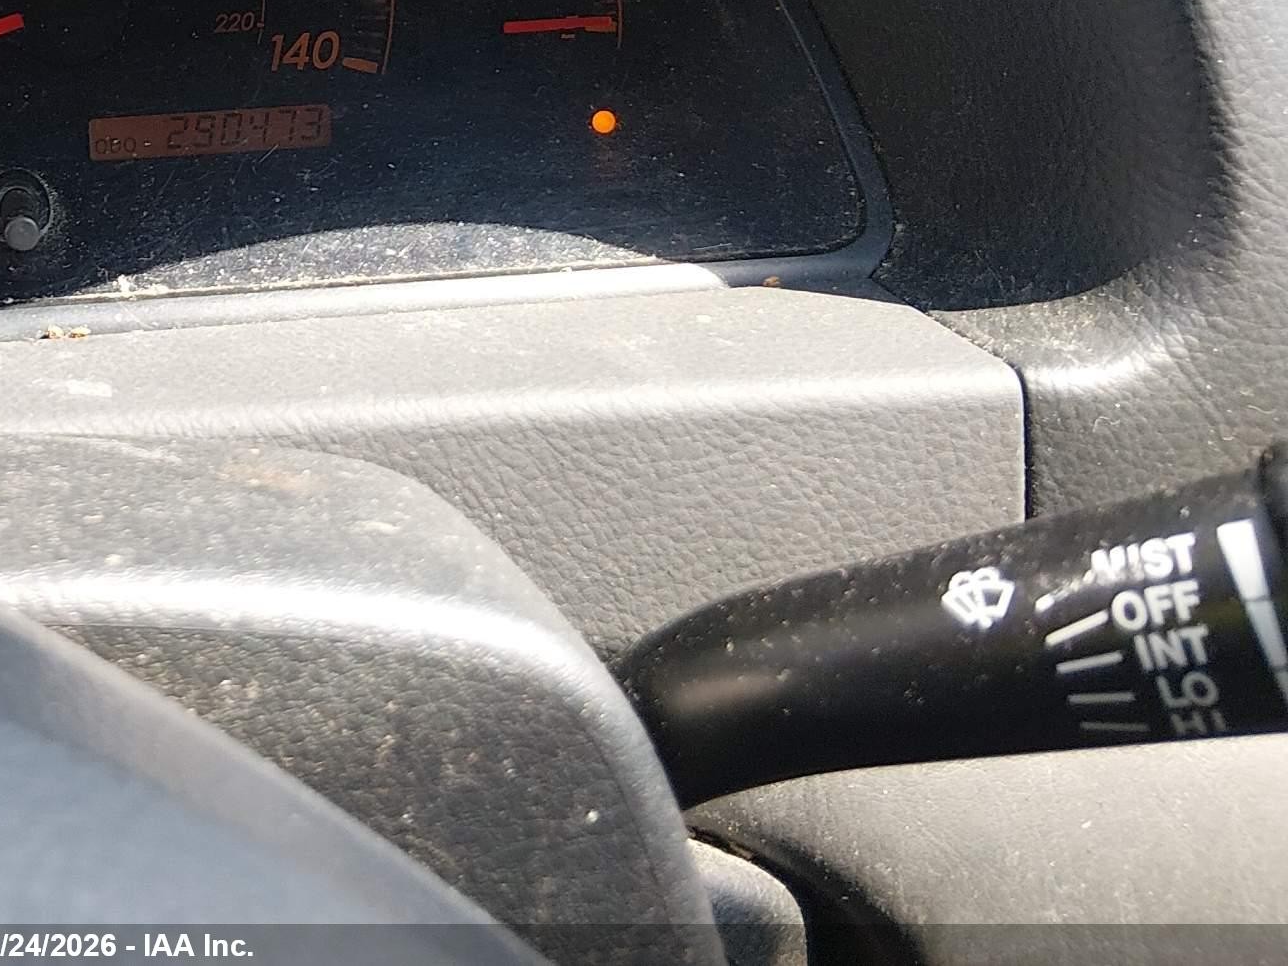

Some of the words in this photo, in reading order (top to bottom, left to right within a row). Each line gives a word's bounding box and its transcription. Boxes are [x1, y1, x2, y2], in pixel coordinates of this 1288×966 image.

[215, 11, 255, 33] 220
[272, 30, 342, 70] 140
[166, 107, 325, 150] 290473
[1085, 532, 1196, 583] MIST
[1112, 580, 1201, 633] OFF
[1134, 625, 1209, 671] INT
[1158, 672, 1219, 709] LO
[1171, 709, 1226, 736] HI
